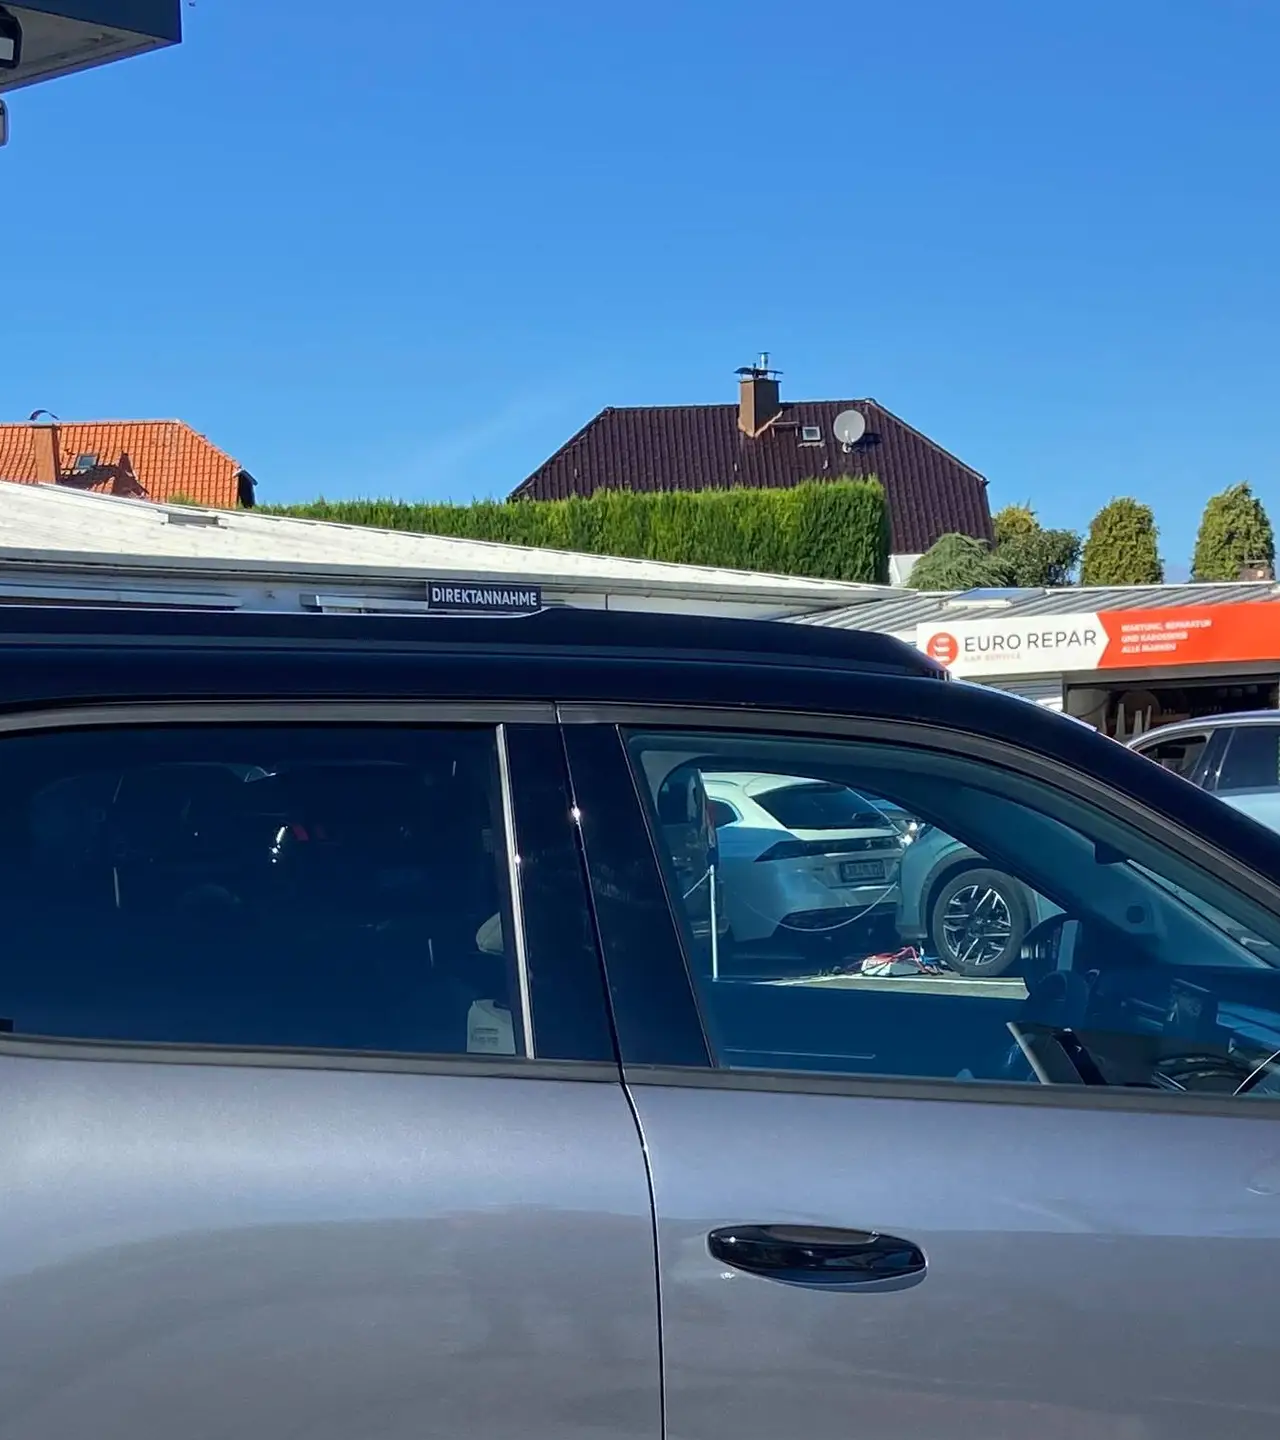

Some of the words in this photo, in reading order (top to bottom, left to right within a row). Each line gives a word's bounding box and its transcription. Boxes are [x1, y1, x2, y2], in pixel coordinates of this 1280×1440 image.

[431, 587, 537, 606] DIREKTANNAHME
[964, 634, 1021, 652] EURO
[1027, 629, 1097, 648] REPAR
